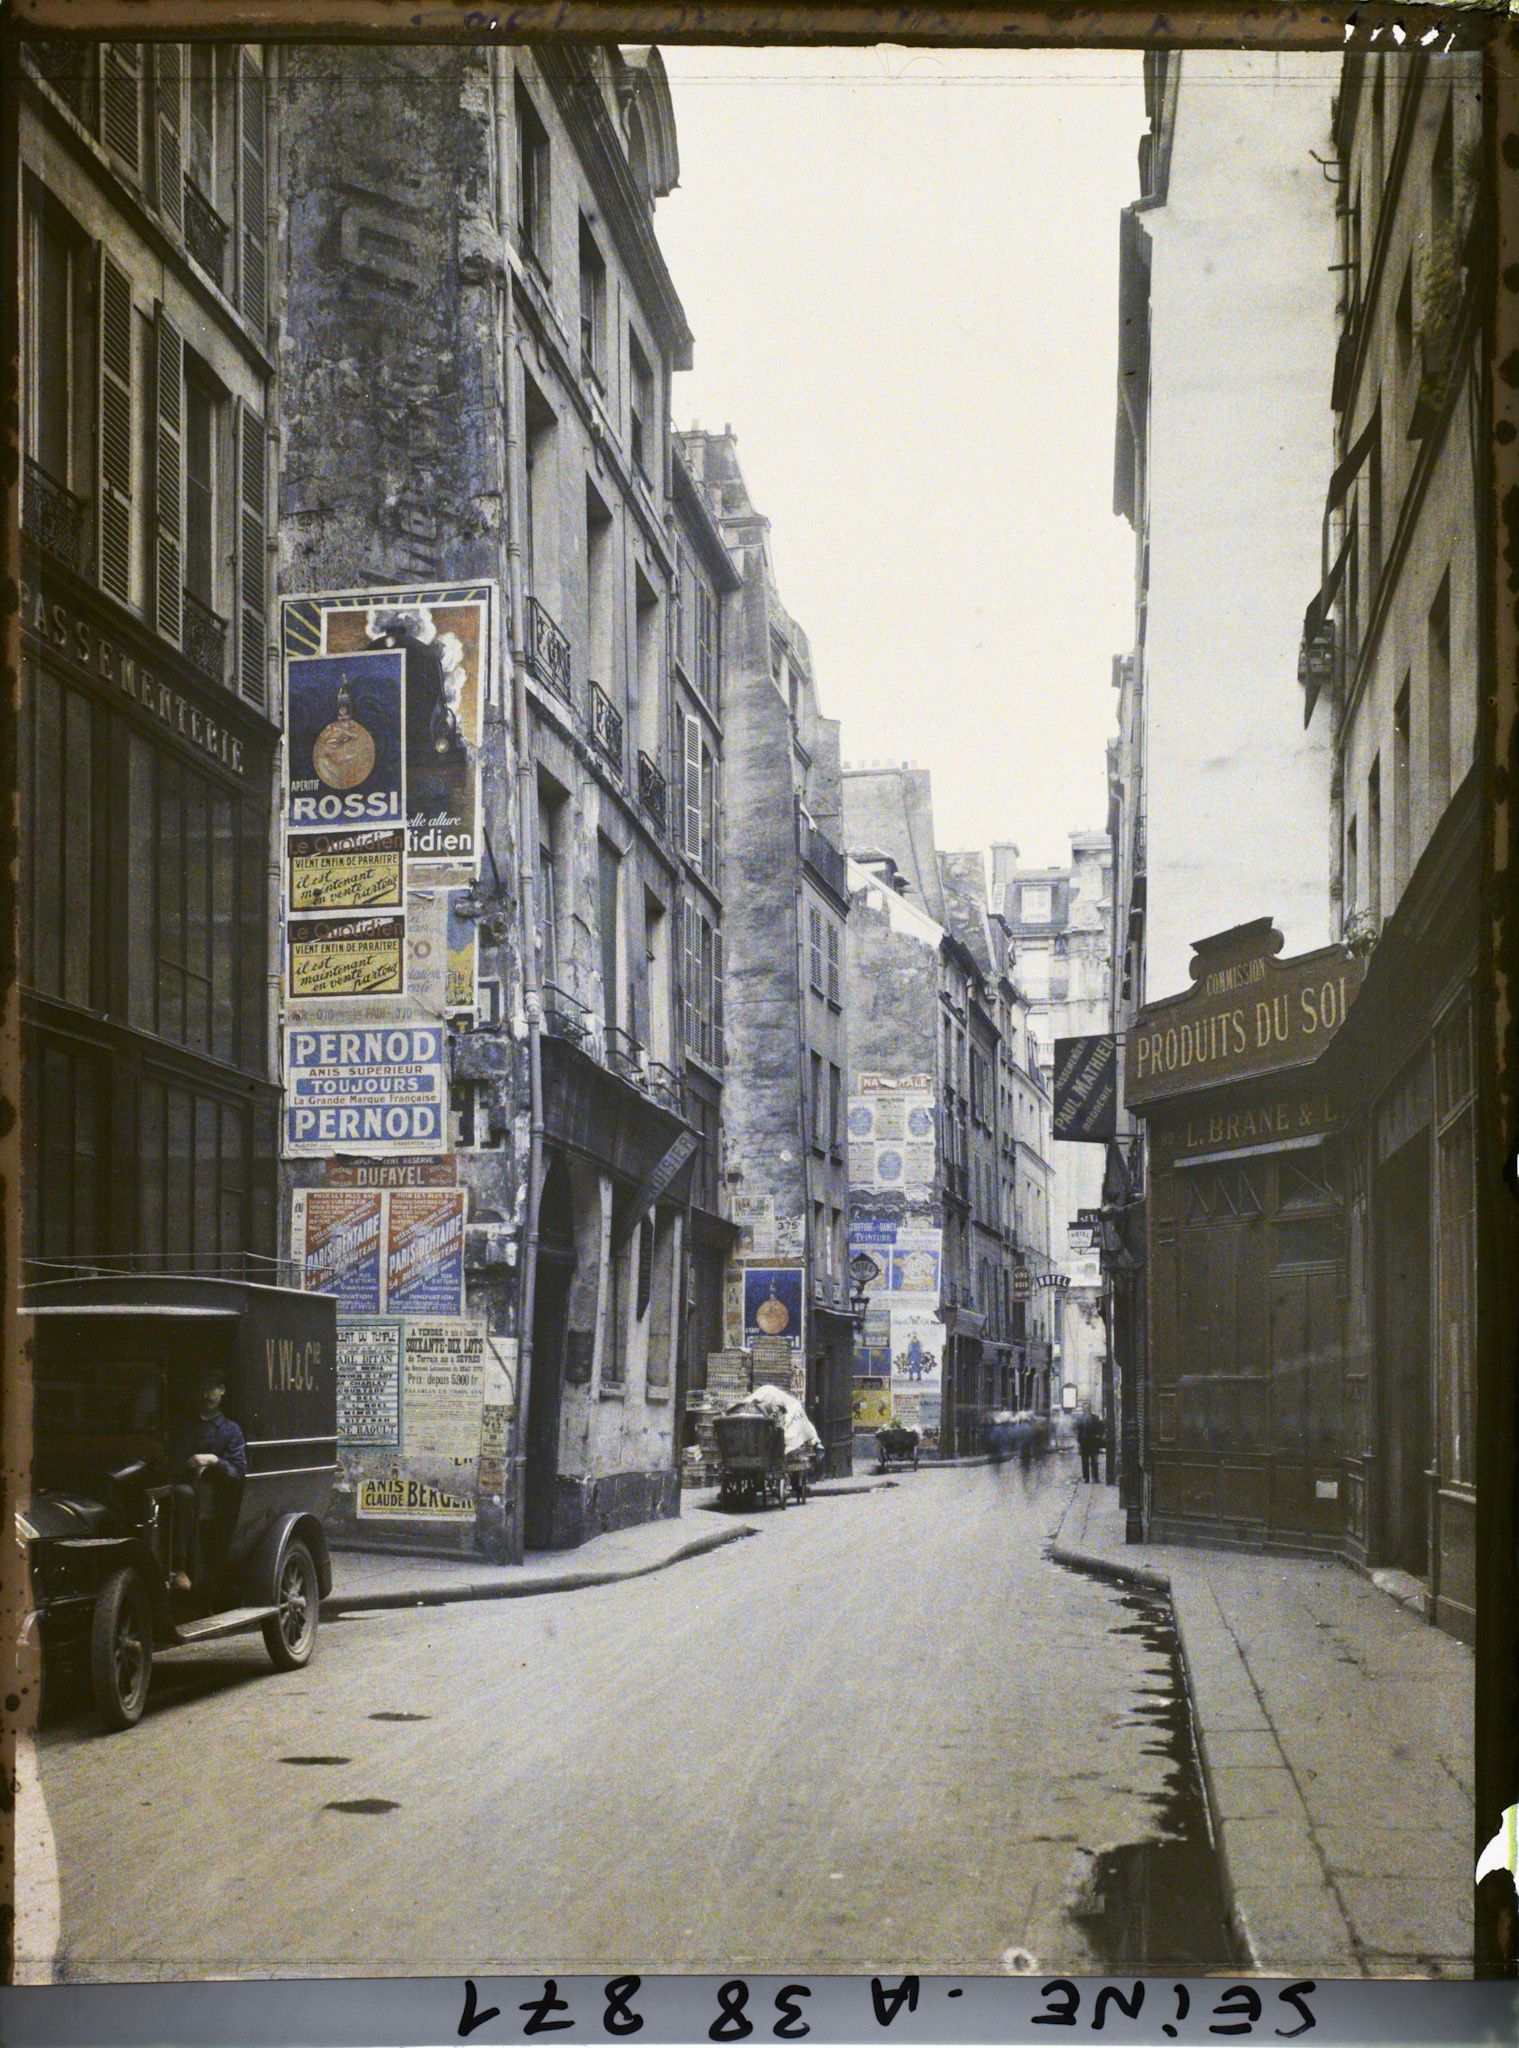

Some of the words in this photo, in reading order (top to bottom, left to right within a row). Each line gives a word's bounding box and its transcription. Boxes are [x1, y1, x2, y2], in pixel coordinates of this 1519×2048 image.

[293, 791, 398, 820] ROSSI
[428, 812, 462, 826] allure
[407, 829, 472, 852] tidien
[295, 858, 318, 869] VIENT
[321, 856, 344, 868] ENFIN
[347, 855, 356, 865] DE
[297, 873, 310, 889] il
[311, 870, 332, 885] est
[301, 868, 377, 900] mintenant
[295, 944, 319, 955] VIENT
[321, 943, 344, 953] ENFIN
[346, 943, 356, 952] DE
[296, 960, 310, 975] il
[312, 955, 332, 971] est
[300, 954, 376, 986] maintenant
[313, 981, 327, 991] en
[330, 967, 365, 988] vente
[353, 961, 398, 993] partout
[1207, 957, 1266, 997] COMMISSION
[1137, 1010, 1247, 1078] PRODUITS
[1257, 995, 1289, 1048] DU
[296, 1030, 436, 1065] PERNOD
[309, 1068, 341, 1077] ANIS
[311, 1077, 419, 1094] TOUJOURS
[1054, 1097, 1081, 1131] PAUL
[1072, 1036, 1116, 1101] MATHIEU
[294, 1096, 304, 1105] La
[308, 1096, 345, 1105] Grande
[350, 1095, 385, 1107] Marque
[389, 1094, 437, 1106] Française
[1082, 1084, 1114, 1132] BRODERIE
[295, 1106, 435, 1140] PERNOD
[357, 1166, 425, 1186] DUFAYEL
[418, 1328, 443, 1336] VENDRE
[464, 1338, 483, 1353] LOTS
[337, 1355, 357, 1364] ARL
[427, 1374, 449, 1387] depuis
[367, 1481, 404, 1493] ANIS
[365, 1494, 404, 1507] CLAUDE
